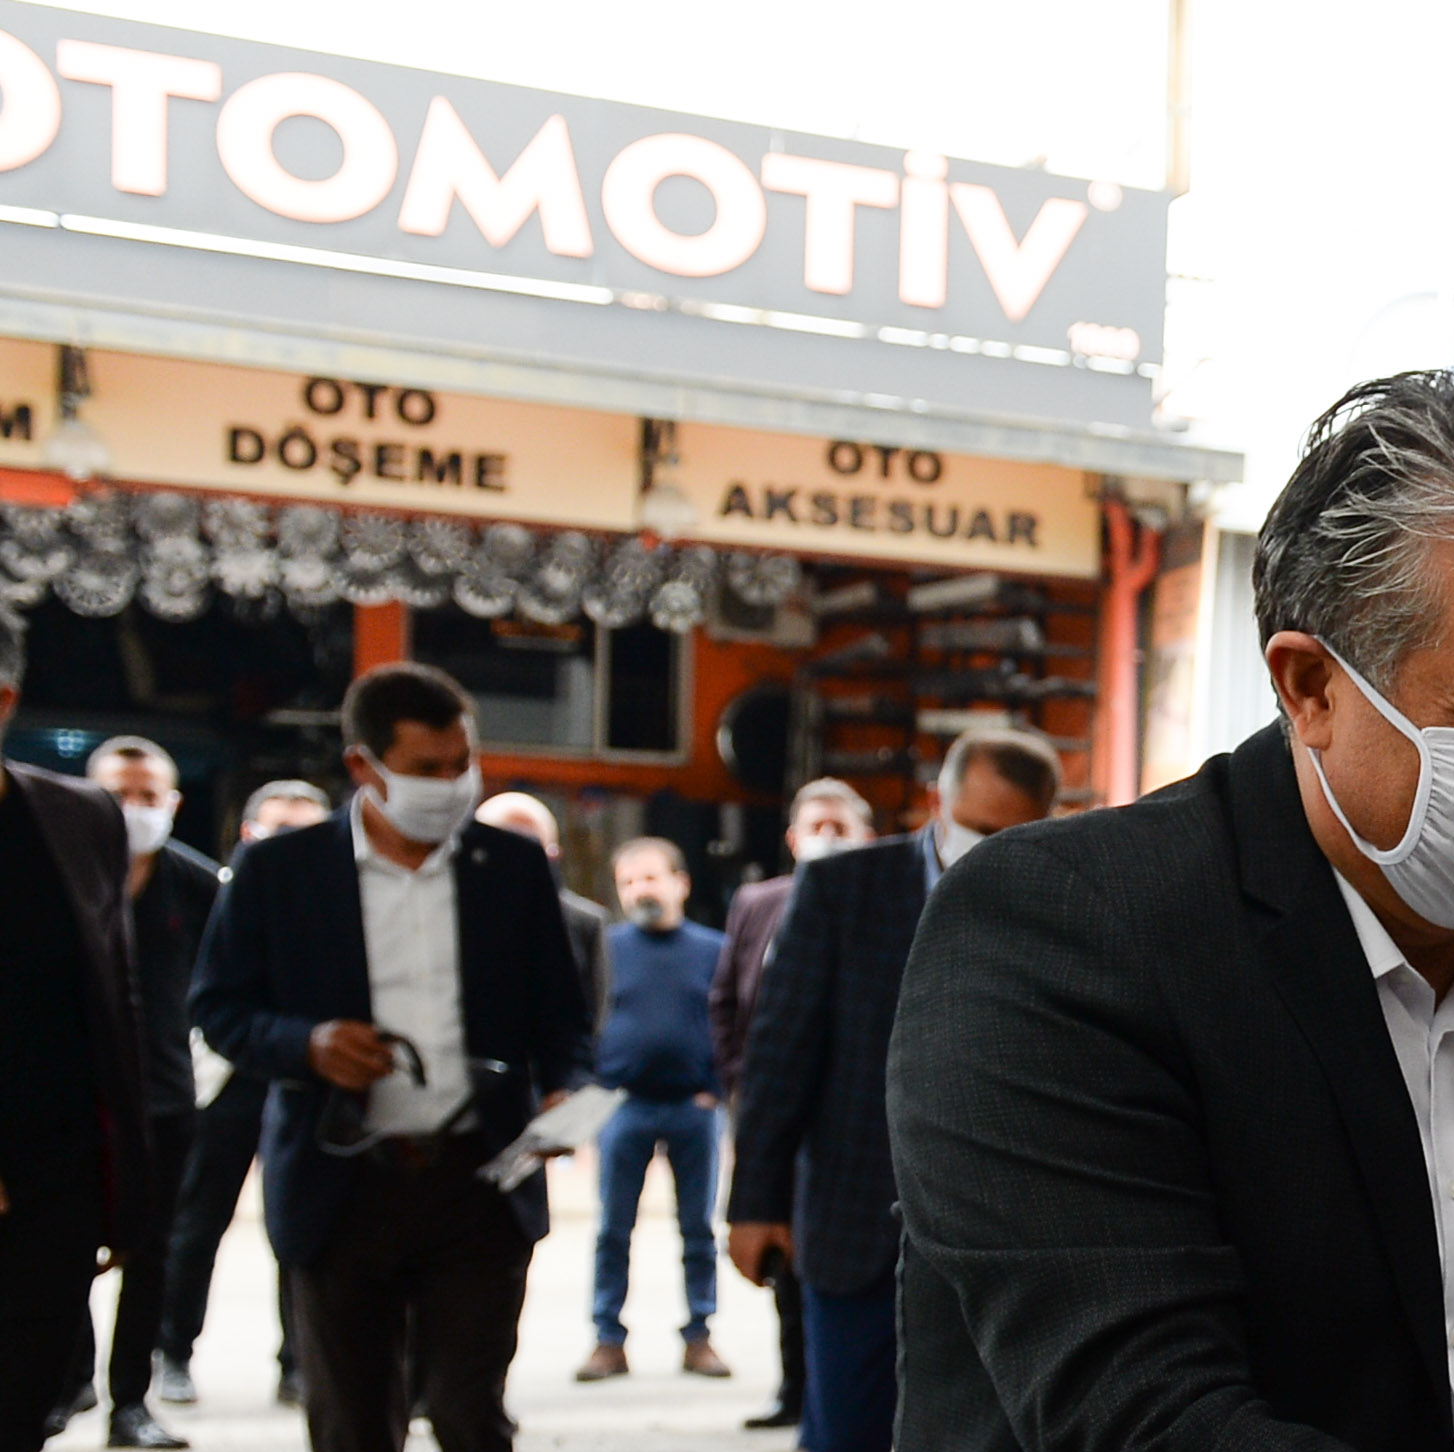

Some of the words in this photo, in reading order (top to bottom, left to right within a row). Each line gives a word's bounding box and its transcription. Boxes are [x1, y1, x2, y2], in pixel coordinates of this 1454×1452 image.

[304, 376, 435, 426] OTO
[227, 424, 508, 492] DÖŞEME
[827, 440, 943, 484] OTO
[720, 482, 1039, 548] AKSESUAR
